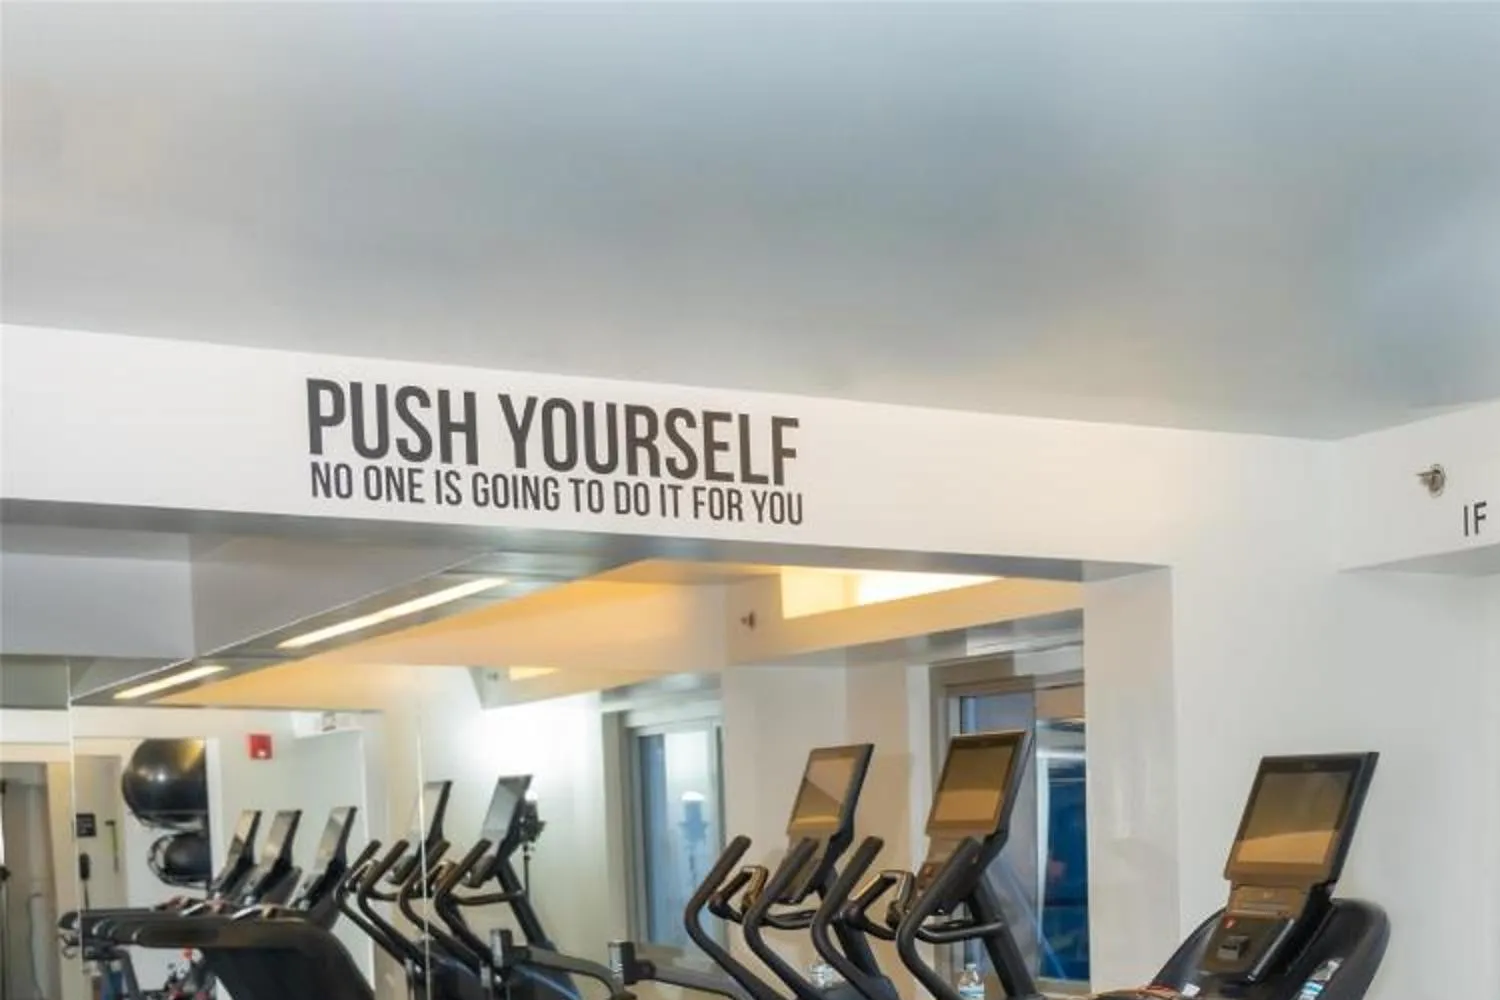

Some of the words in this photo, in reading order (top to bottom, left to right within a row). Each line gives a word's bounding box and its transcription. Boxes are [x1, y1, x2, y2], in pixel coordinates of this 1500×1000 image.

[306, 378, 479, 466] PUSH
[497, 393, 799, 486] YOURSELF
[310, 461, 353, 499] NO
[363, 465, 425, 504] ONE
[434, 469, 463, 506] IS
[471, 471, 560, 513] GOING
[568, 477, 605, 514] TO
[613, 480, 650, 517] DO
[659, 483, 684, 518] IT
[692, 485, 744, 522] FOR
[751, 490, 803, 526] YOU
[1462, 501, 1488, 537] IF
